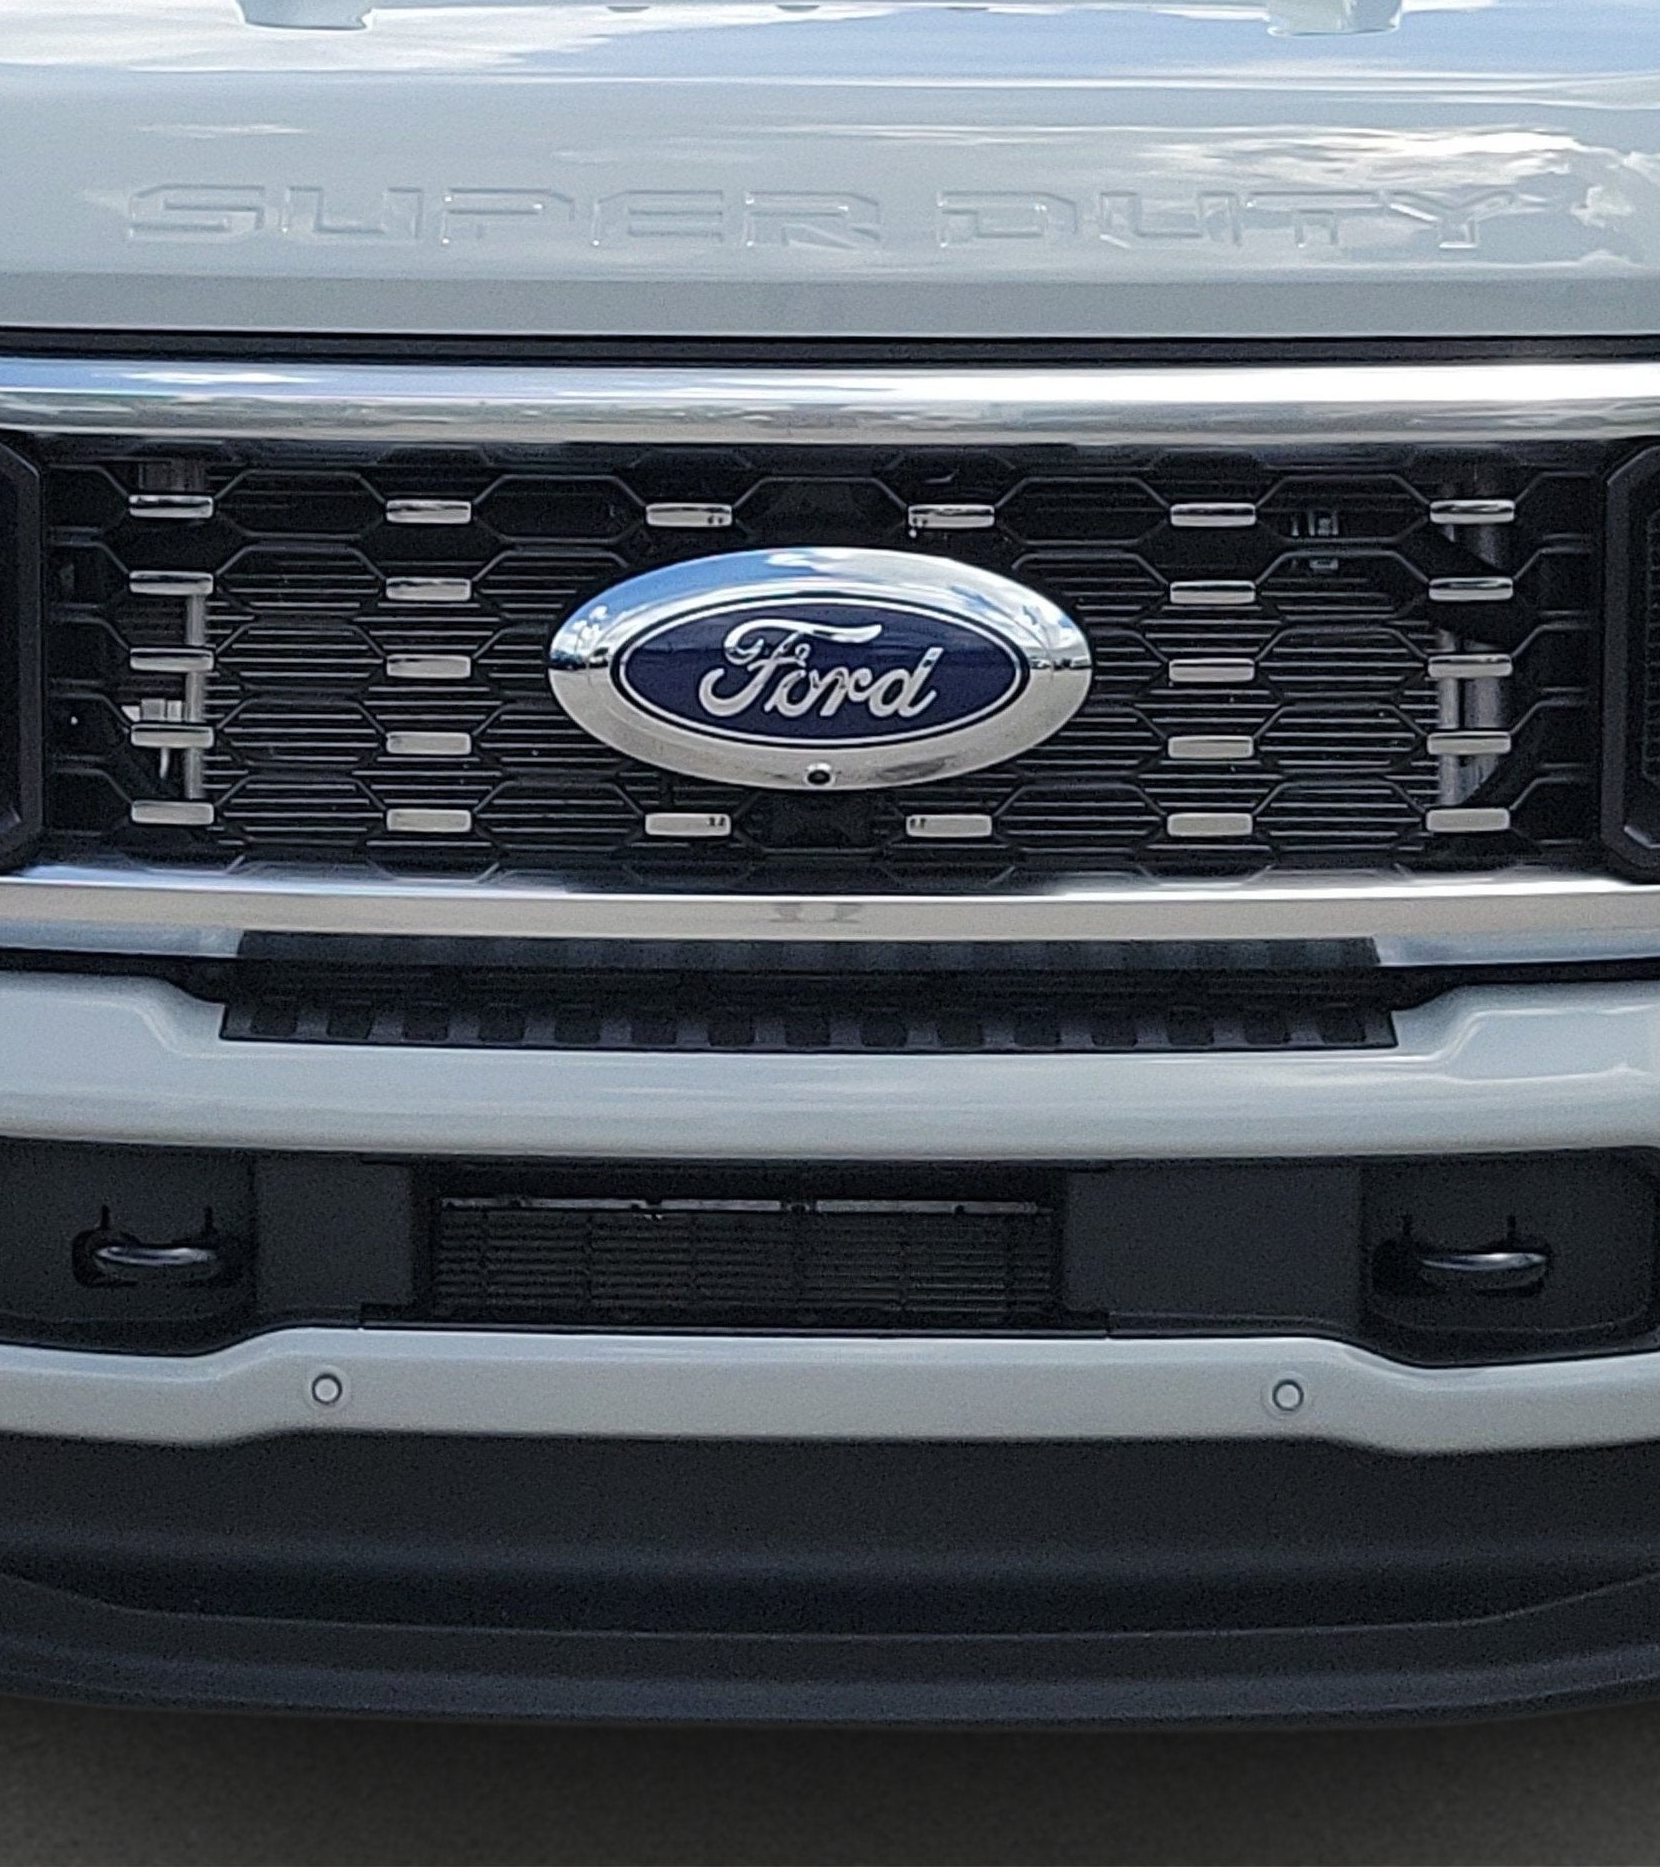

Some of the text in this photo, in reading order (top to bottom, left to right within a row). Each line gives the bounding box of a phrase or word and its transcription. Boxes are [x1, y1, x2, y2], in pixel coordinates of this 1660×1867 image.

[128, 184, 1518, 250] SUPER DUTY
[698, 618, 944, 718] Ford
